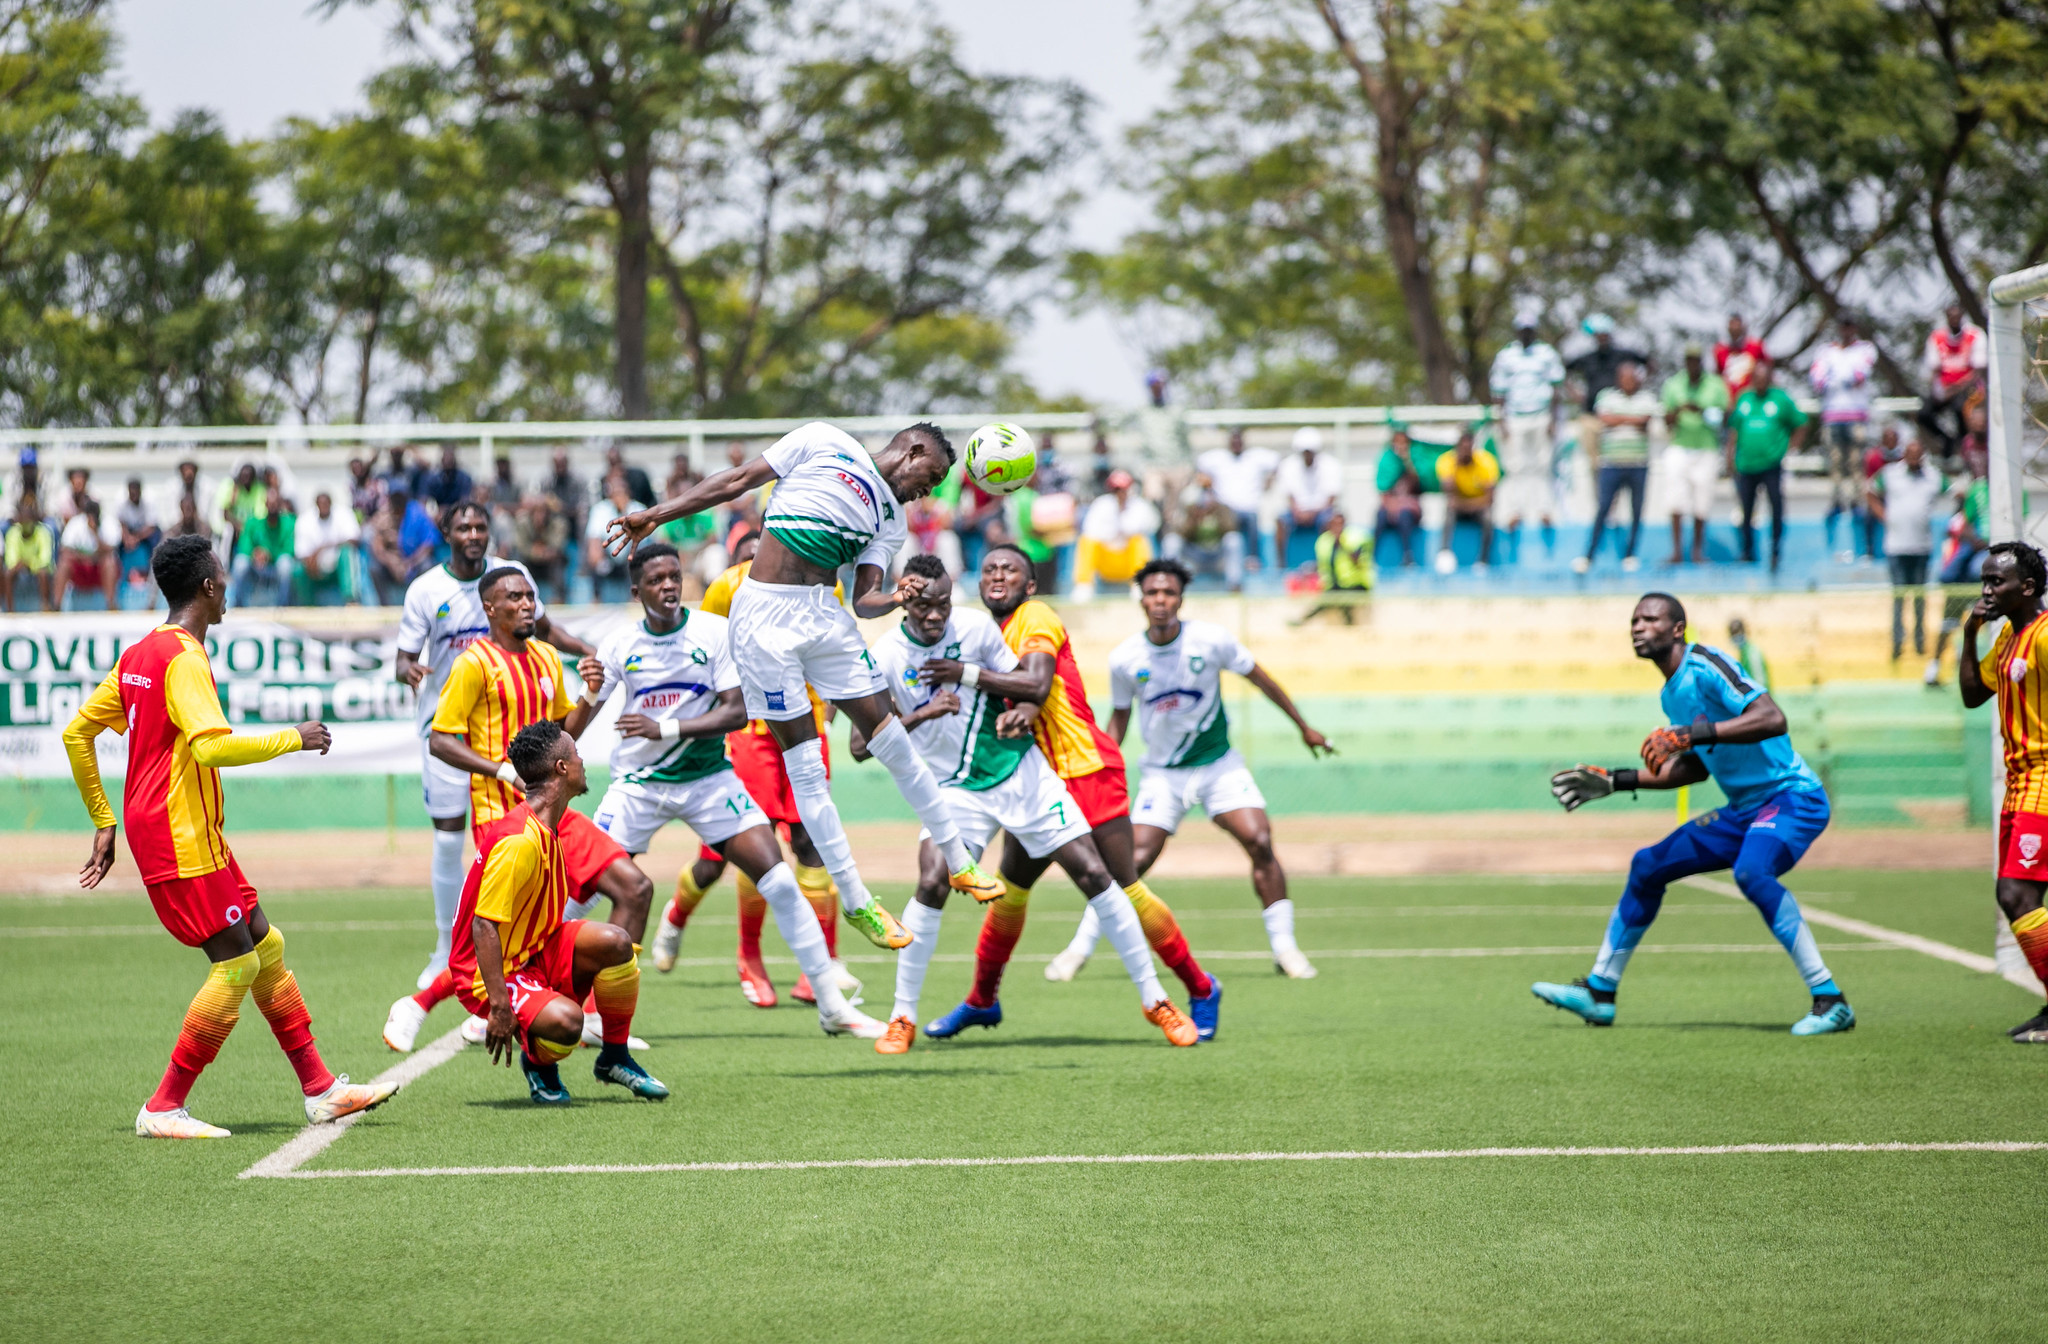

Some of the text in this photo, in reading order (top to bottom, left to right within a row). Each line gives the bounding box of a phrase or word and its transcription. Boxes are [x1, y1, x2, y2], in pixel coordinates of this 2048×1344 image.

[228, 679, 324, 724] Fan
[331, 677, 417, 722] Clu
[641, 691, 682, 709] azam
[725, 793, 754, 815] 12
[1048, 800, 1066, 825] 7
